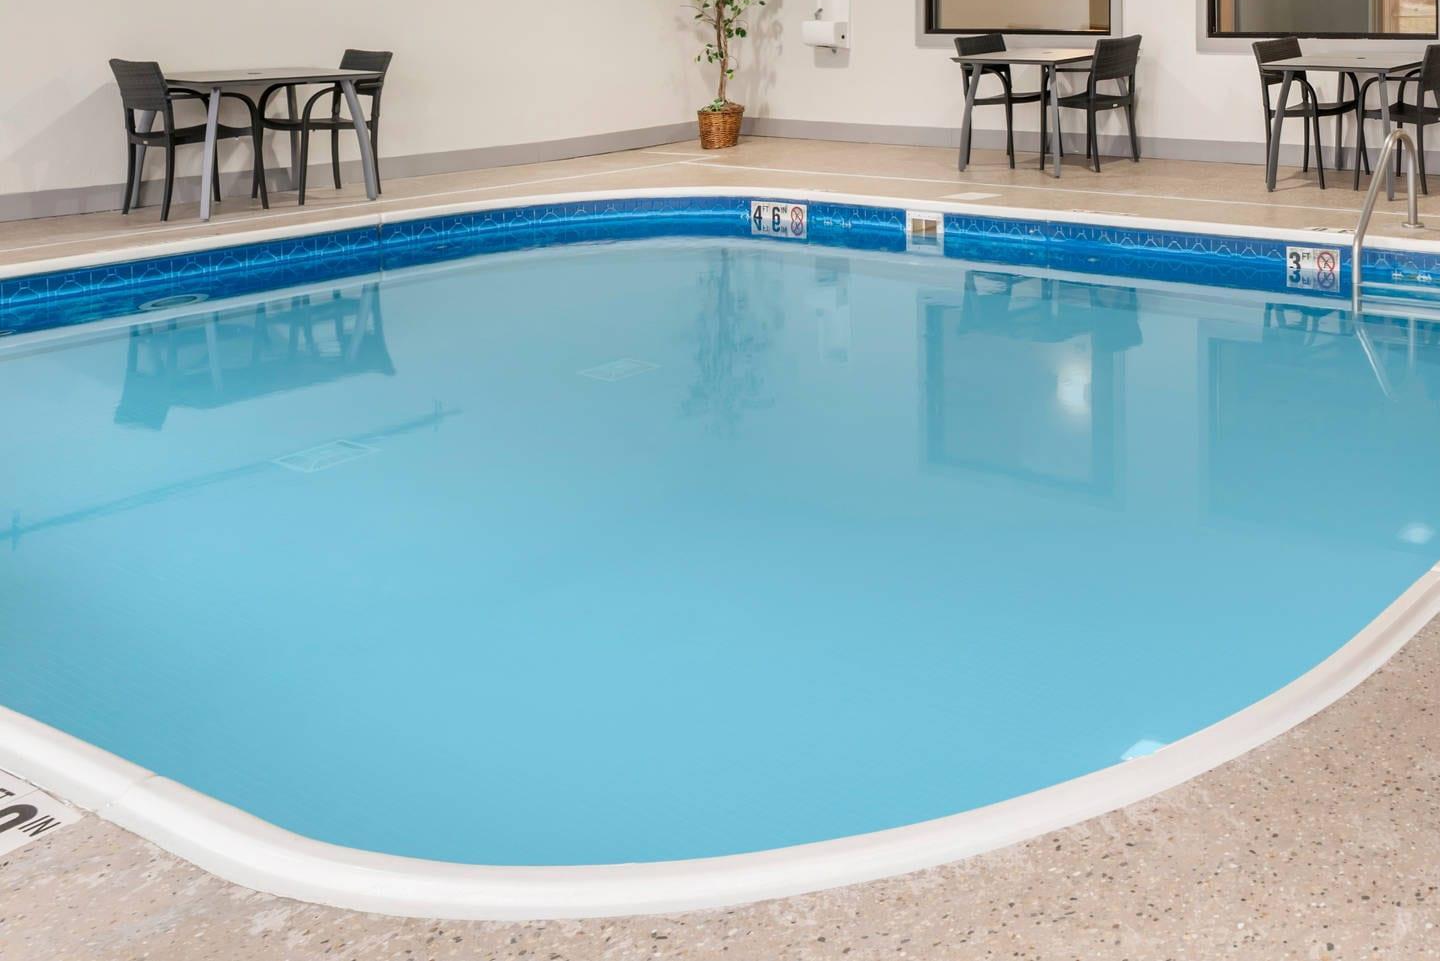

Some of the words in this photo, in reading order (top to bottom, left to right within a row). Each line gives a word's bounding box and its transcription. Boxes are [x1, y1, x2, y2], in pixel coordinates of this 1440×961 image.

[753, 205, 762, 220] 4
[772, 206, 780, 221] 6
[1289, 252, 1301, 271] 3
[18, 815, 61, 837] IN
